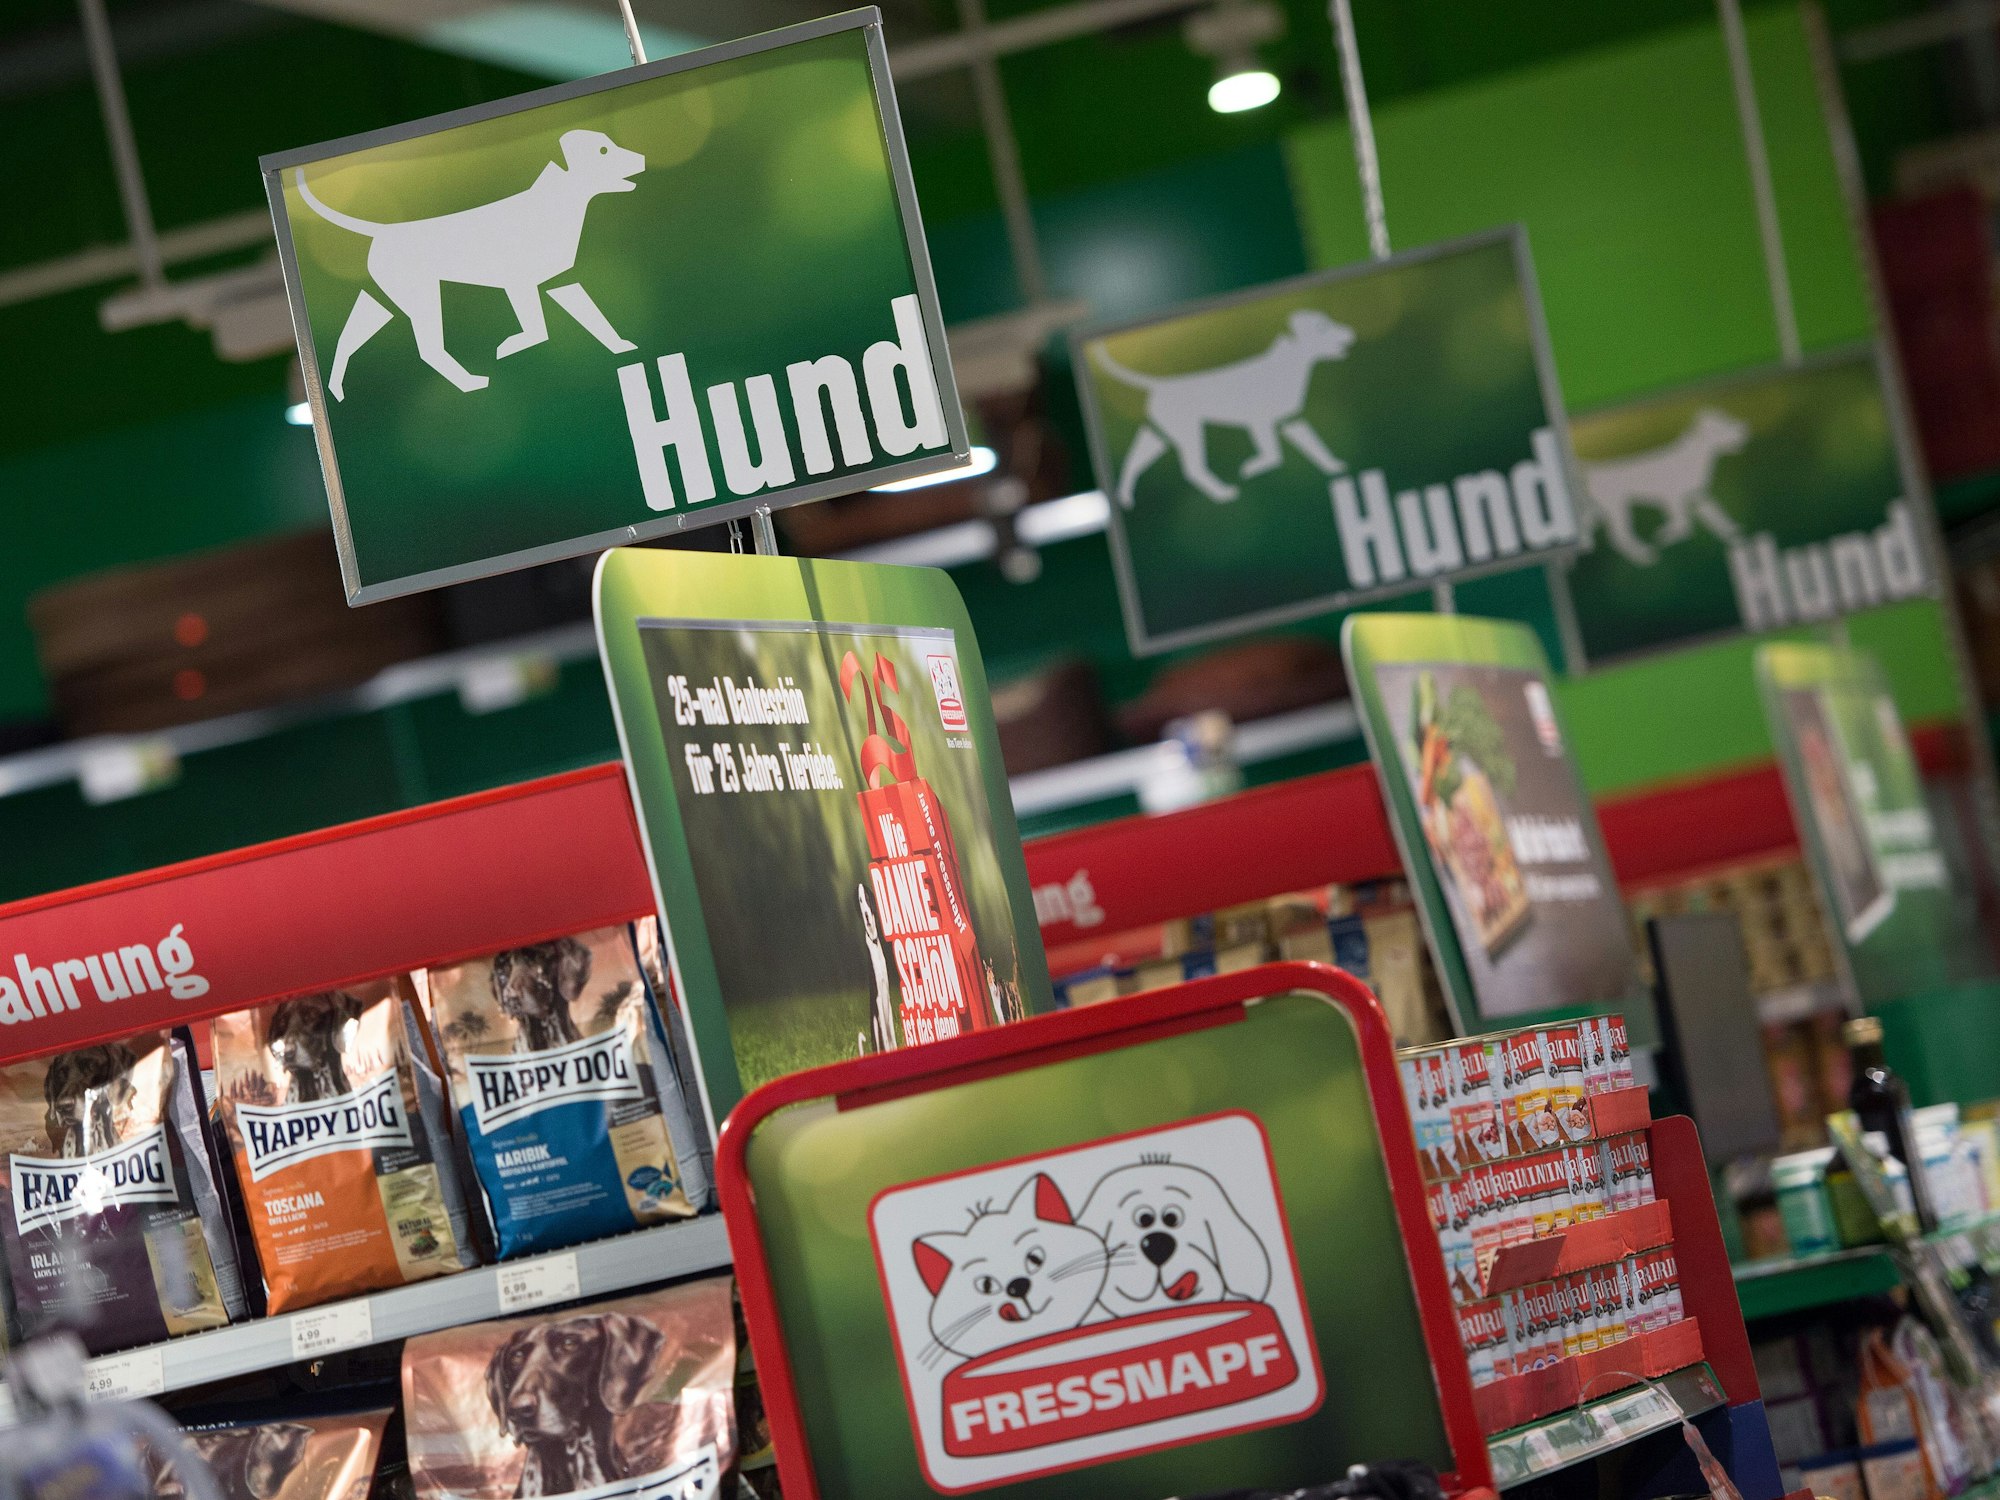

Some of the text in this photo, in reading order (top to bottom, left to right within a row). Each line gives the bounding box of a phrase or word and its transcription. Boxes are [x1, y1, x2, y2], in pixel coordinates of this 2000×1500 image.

[617, 293, 950, 512] Hund
[1329, 426, 1579, 588] Hund
[1727, 495, 1925, 631] Hund
[667, 675, 810, 726] 25-mal Dankeschön
[684, 743, 843, 794] für 25 Jahre Tierliebe.
[878, 813, 908, 858] Wie
[917, 792, 967, 934] Jahre Fressnapf
[870, 860, 939, 937] DANKE
[894, 934, 964, 1013] SCHÖN
[901, 1010, 918, 1047] ist
[917, 1008, 934, 1044] das
[477, 1061, 568, 1112] HAPPY
[574, 1043, 629, 1083] DOG
[247, 1089, 399, 1160] HAPPY DOG
[112, 1147, 165, 1187] DOG
[495, 1144, 550, 1169] KARIBIK
[264, 1191, 325, 1216] TOSCANA
[297, 1329, 320, 1342] 4,99
[89, 1378, 112, 1392] 4,99
[950, 1333, 1281, 1443] FRESSNAPF
